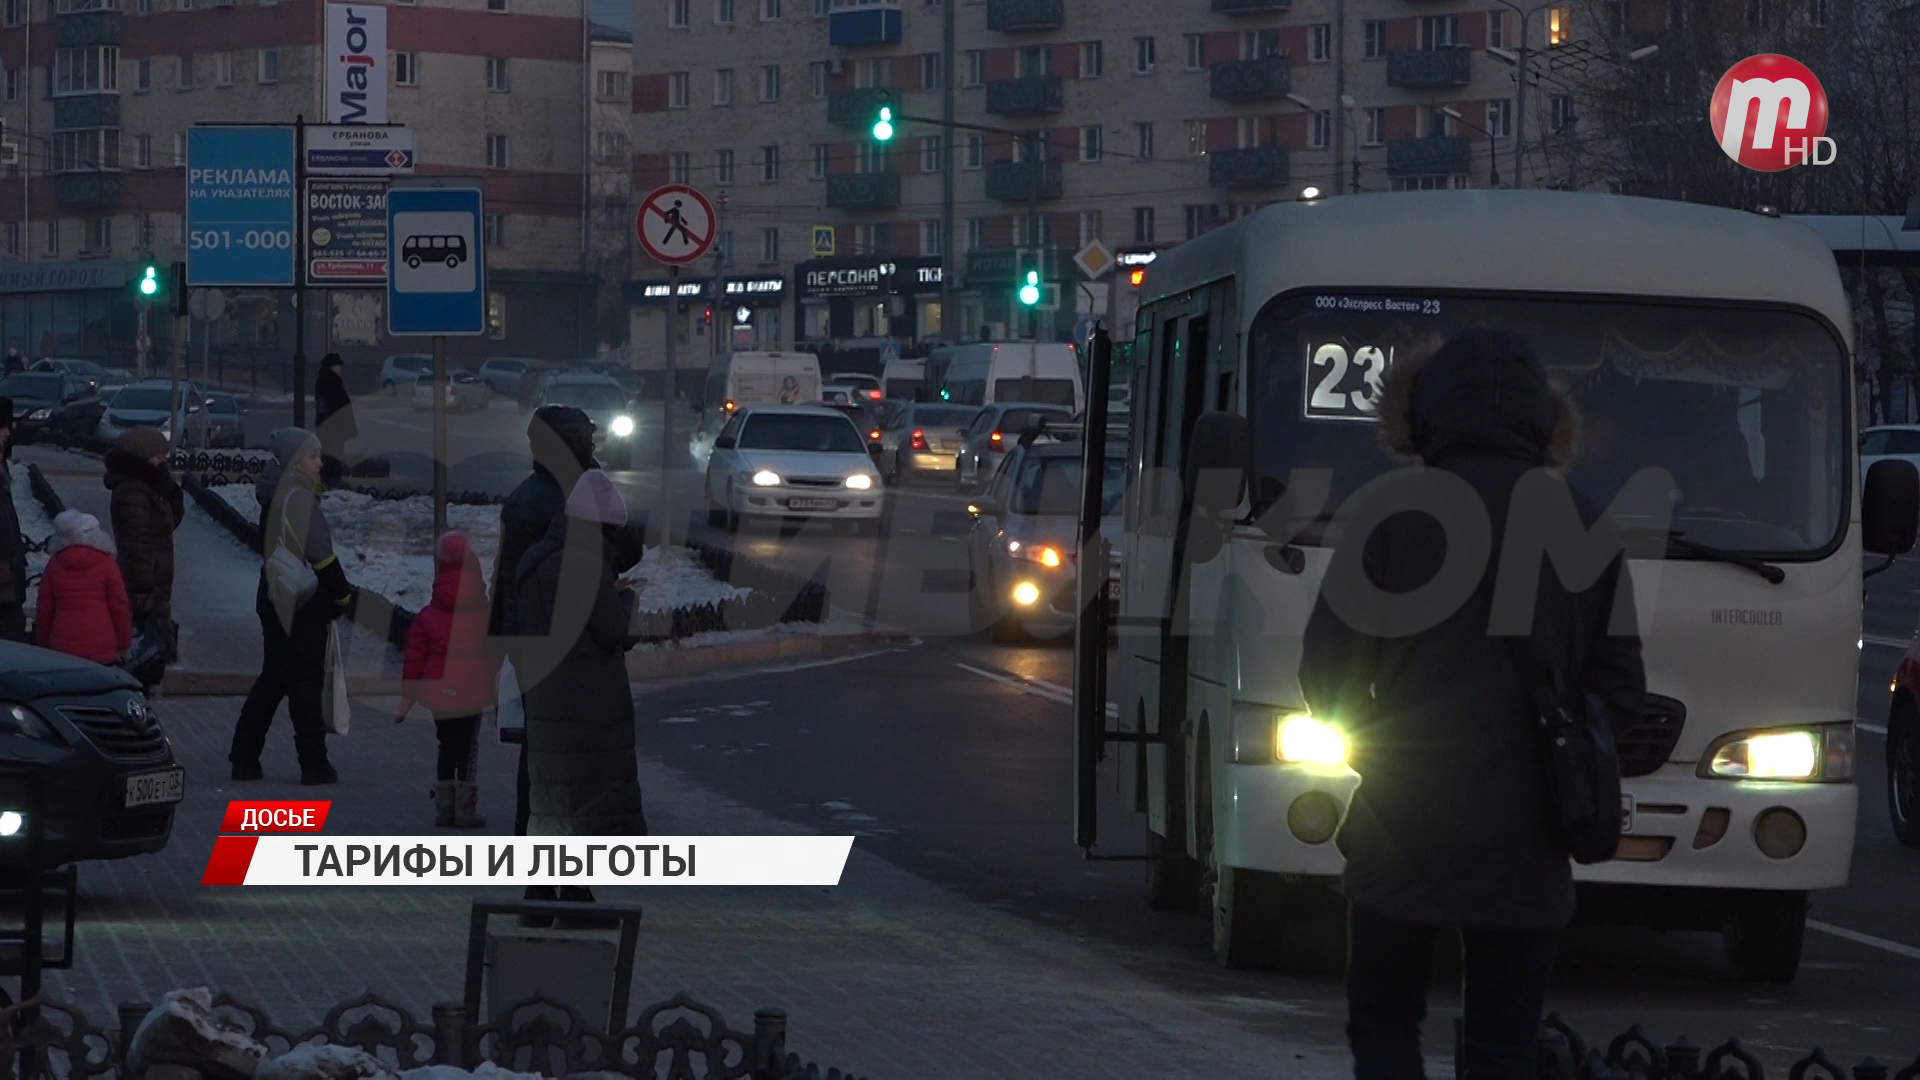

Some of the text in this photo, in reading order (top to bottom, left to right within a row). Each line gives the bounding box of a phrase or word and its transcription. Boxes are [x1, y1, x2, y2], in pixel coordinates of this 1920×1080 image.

[340, 8, 374, 124] Major
[332, 131, 389, 140] ЕРБАНОВА
[190, 169, 291, 185] РЕКЛАМА
[190, 189, 290, 198] НА УКАЗАТЕЛЯХ
[190, 231, 291, 249] 501-000
[807, 268, 879, 286] ПЕРСОНА
[1315, 295, 1440, 314] ООО «Экспресс Восток» 23
[1311, 342, 1385, 412] 23
[1711, 609, 1782, 626] INTERCOOLER
